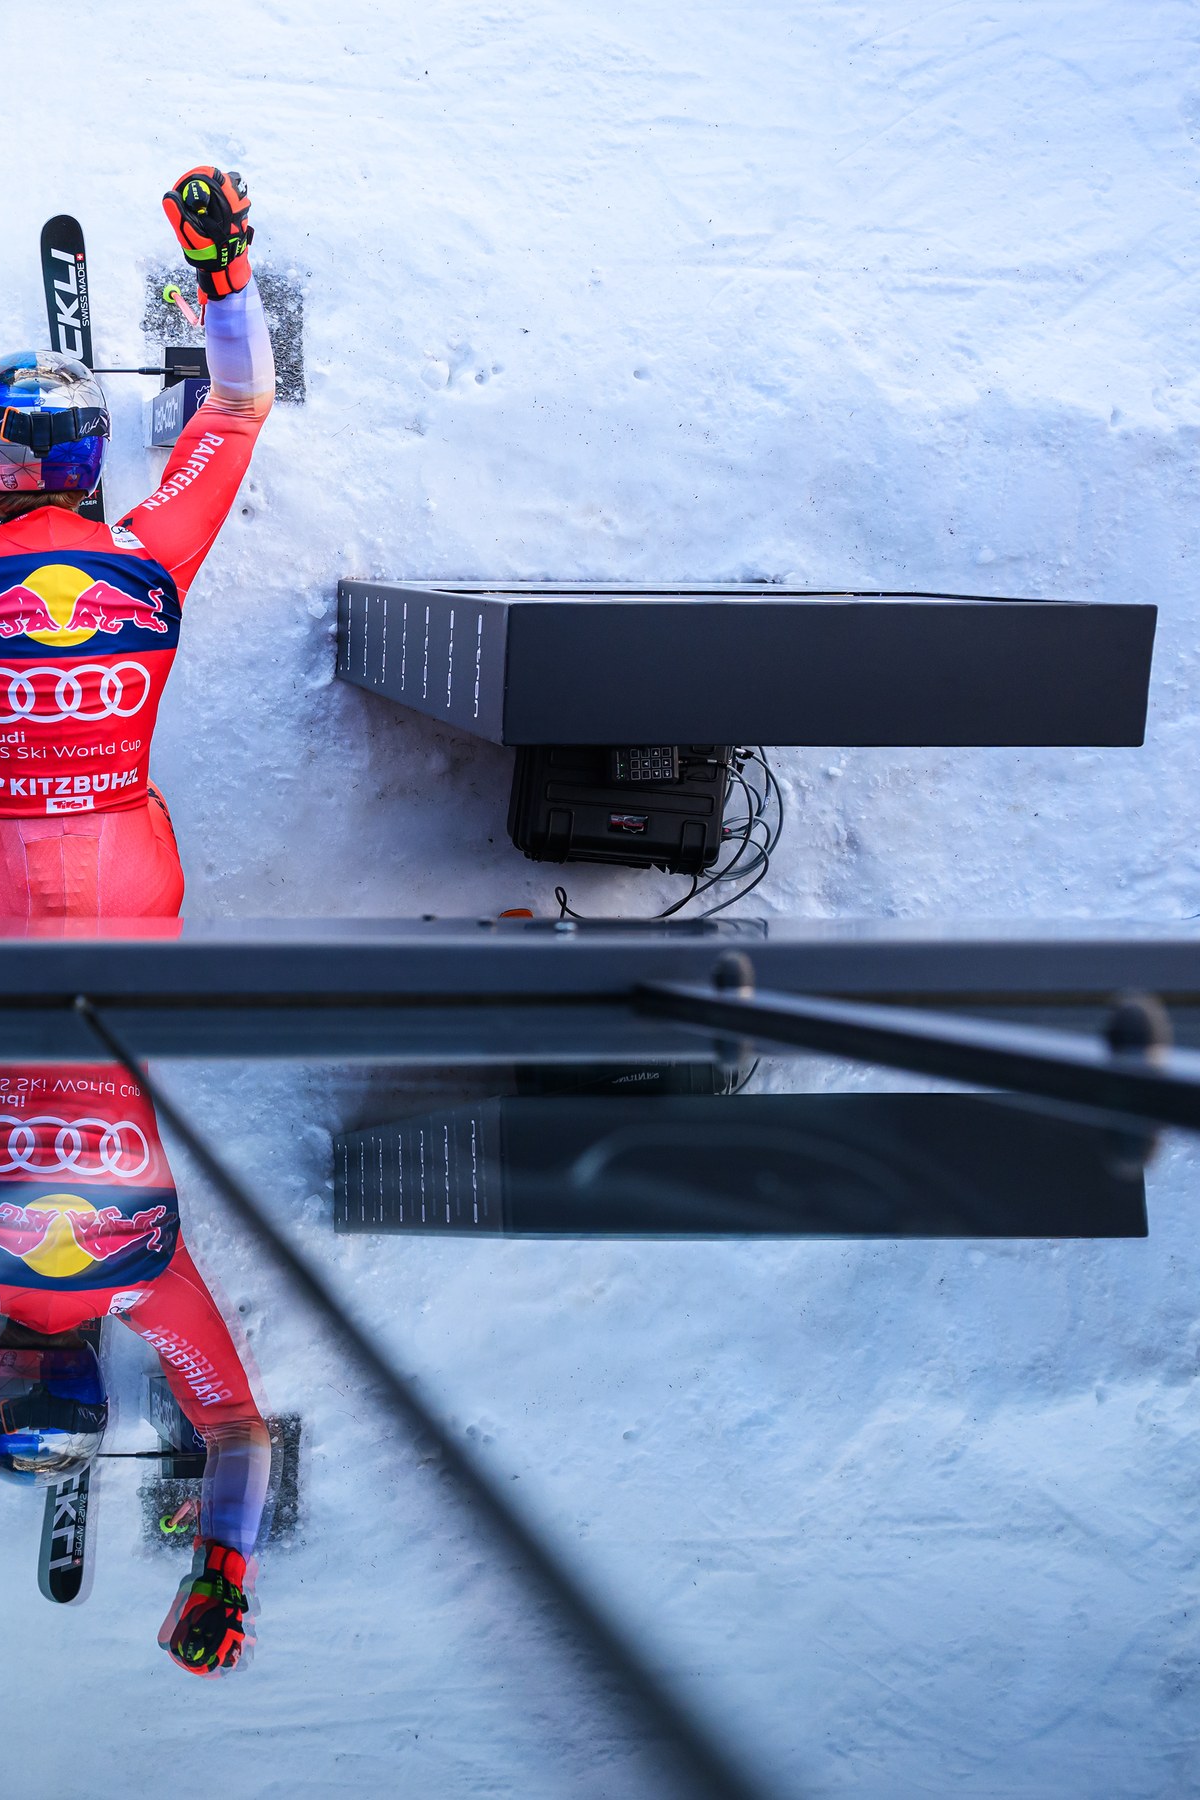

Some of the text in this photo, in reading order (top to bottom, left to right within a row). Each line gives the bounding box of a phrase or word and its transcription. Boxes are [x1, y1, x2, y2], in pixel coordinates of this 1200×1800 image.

[77, 262, 90, 327] SWISS MADE
[142, 432, 225, 511] RAIFFEISEN
[17, 746, 47, 759] Ski
[53, 743, 115, 758] World
[120, 739, 141, 752] Cup
